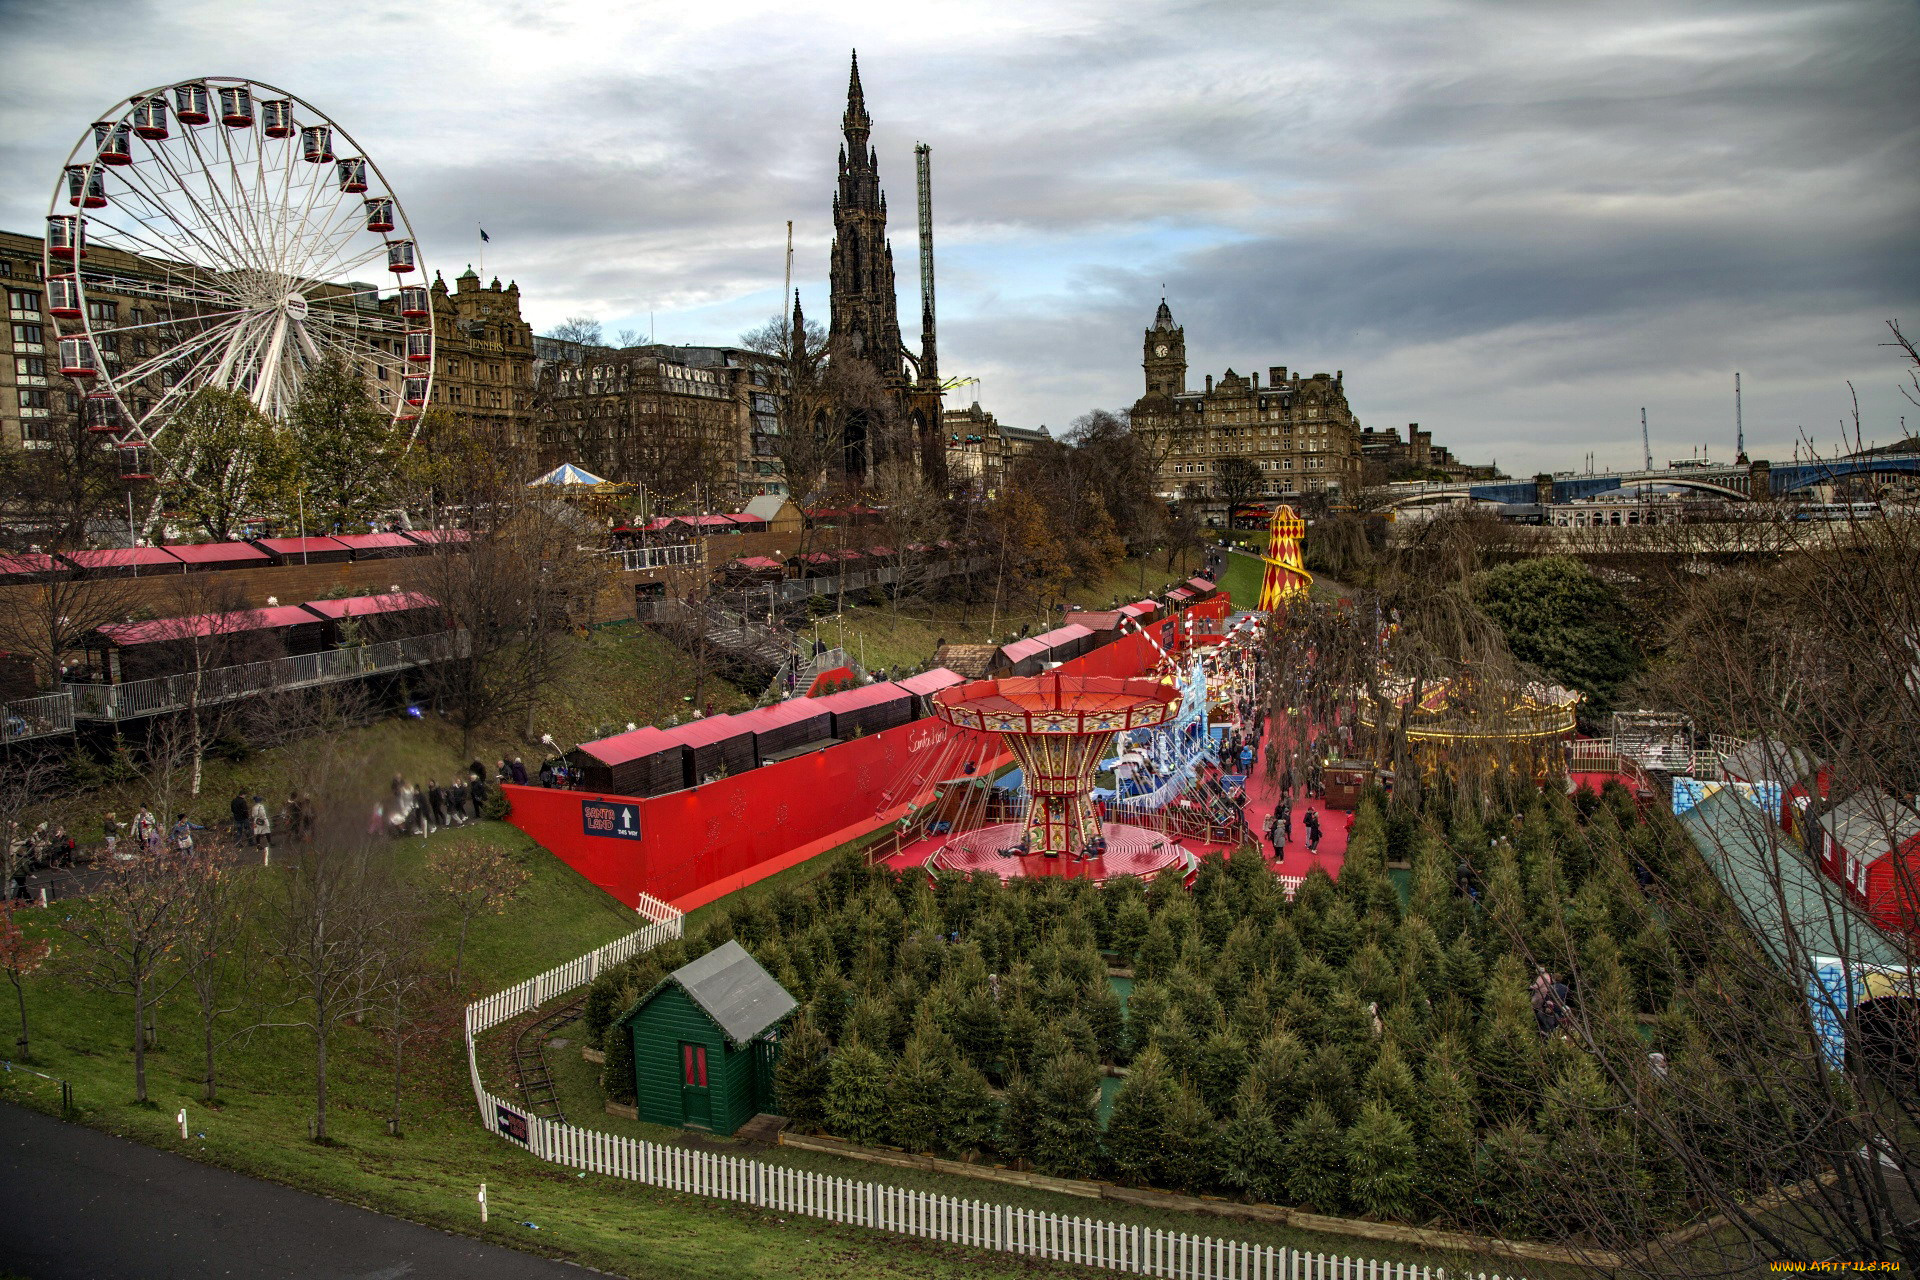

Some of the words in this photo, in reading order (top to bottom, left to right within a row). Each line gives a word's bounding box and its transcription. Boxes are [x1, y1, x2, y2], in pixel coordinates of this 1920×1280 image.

[467, 338, 504, 352] JENNERS
[584, 807, 615, 820] SANTA
[588, 818, 614, 830] LAND
